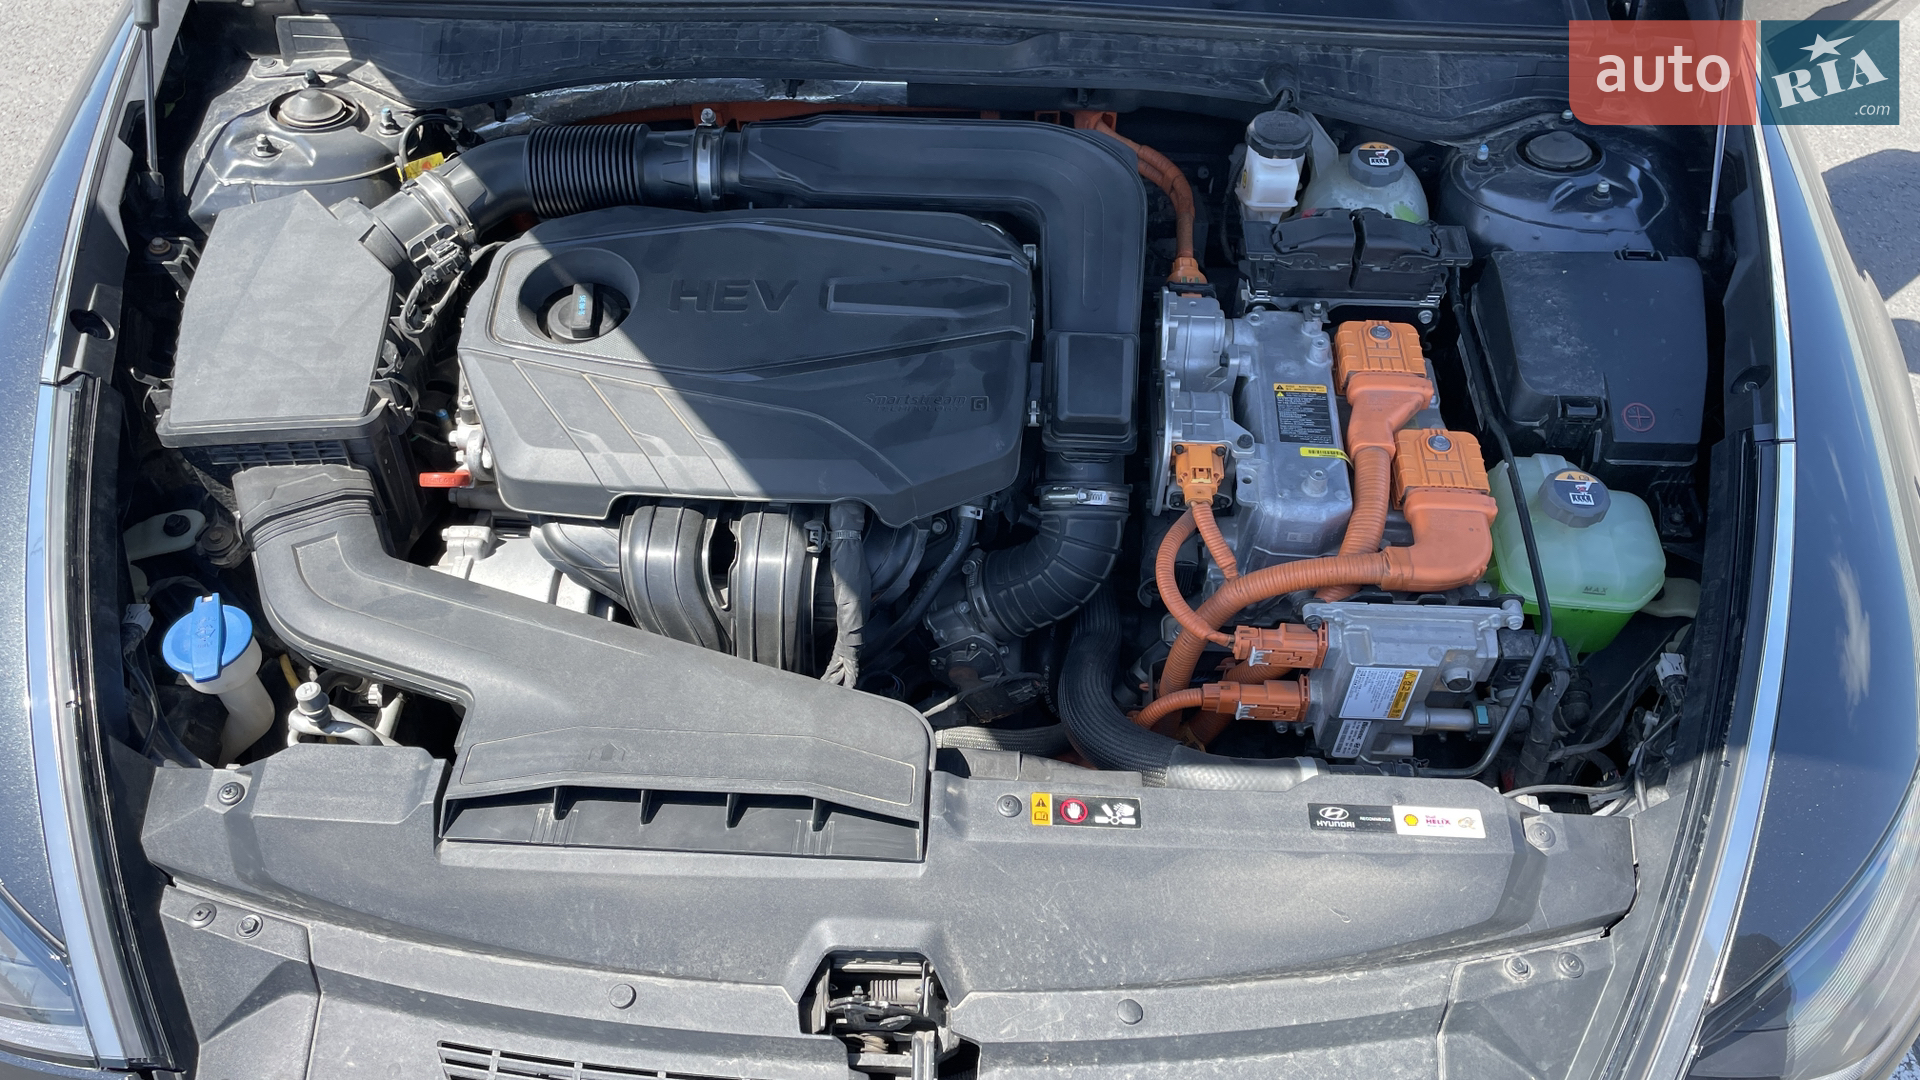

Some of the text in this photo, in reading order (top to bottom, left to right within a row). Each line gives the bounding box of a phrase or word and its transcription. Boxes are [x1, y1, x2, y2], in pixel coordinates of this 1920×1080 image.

[667, 279, 798, 313] HEV
[863, 393, 987, 412] Smartstream G
[1316, 820, 1355, 828] HYUNDAI
